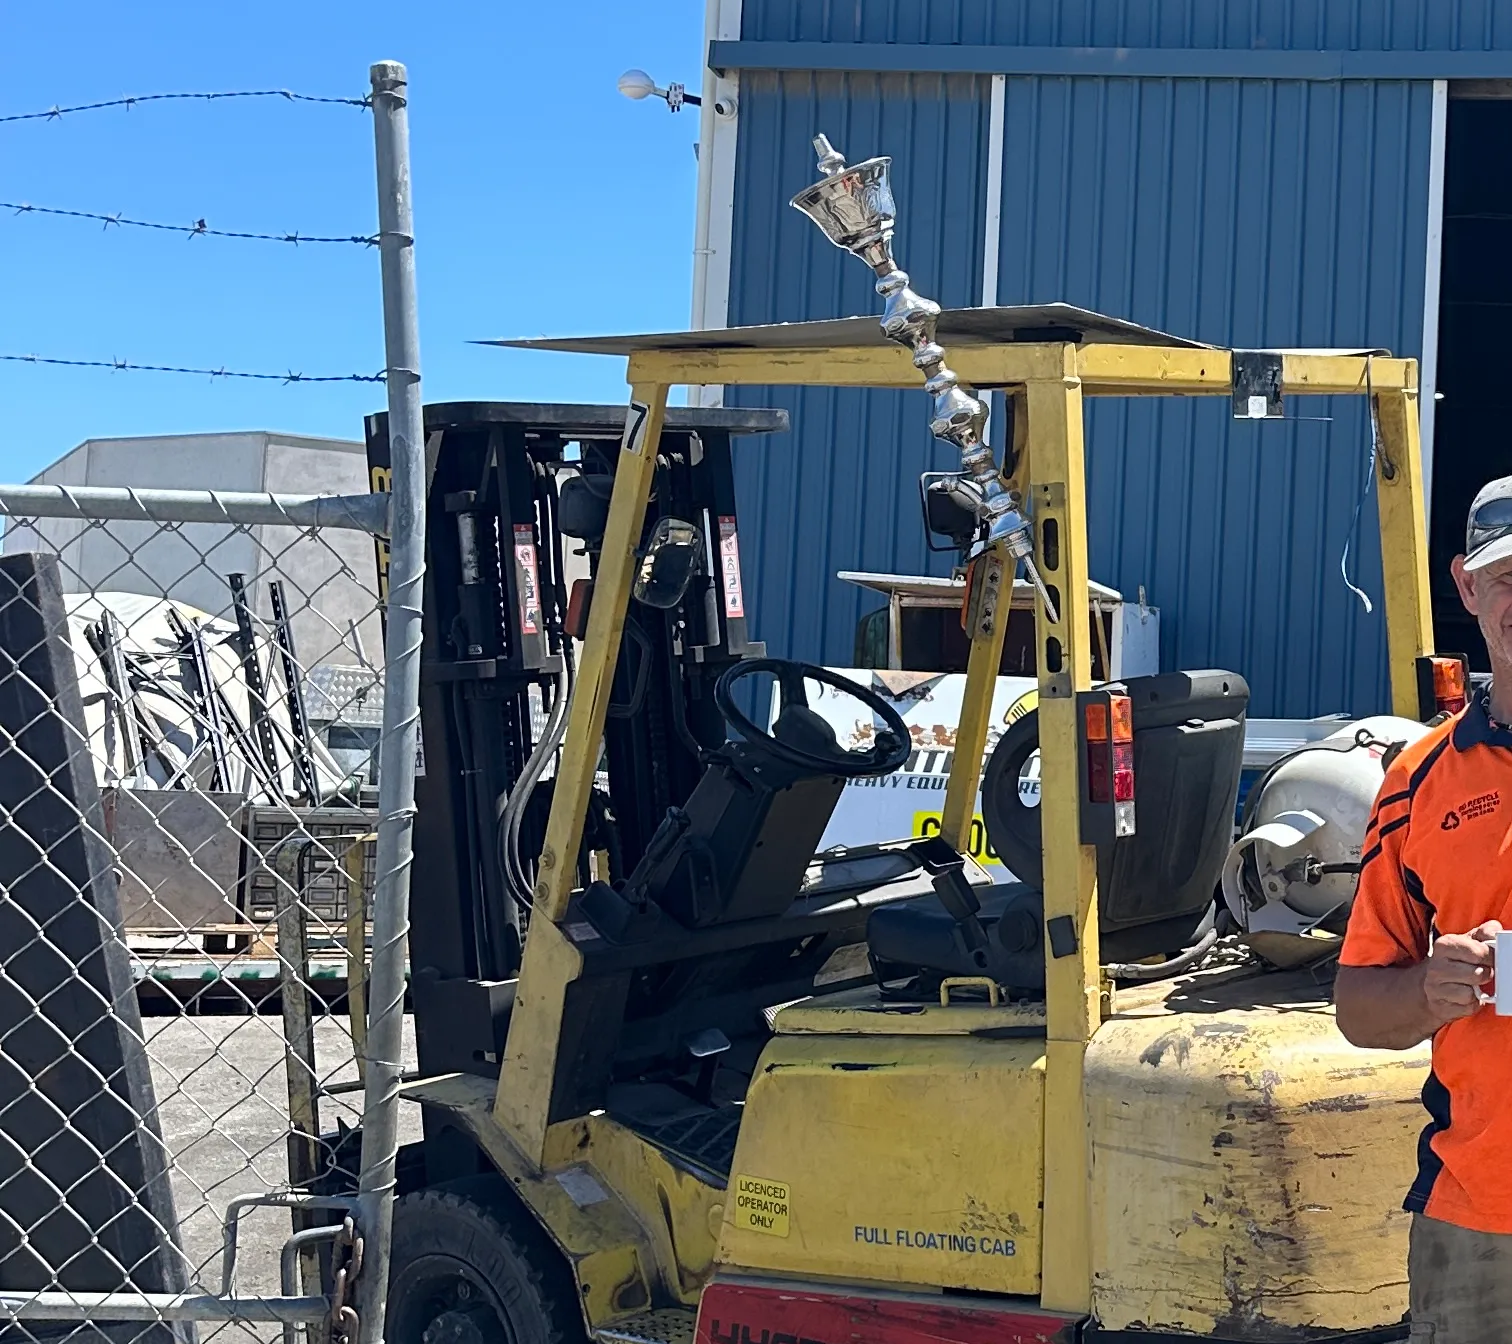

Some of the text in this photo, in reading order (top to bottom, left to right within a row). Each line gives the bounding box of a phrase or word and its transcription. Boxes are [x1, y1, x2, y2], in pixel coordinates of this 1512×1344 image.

[627, 403, 647, 450] 7
[739, 1180, 786, 1199] LICENCED
[737, 1195, 788, 1216] OPERATOR
[750, 1213, 774, 1229] ONLY
[854, 1226, 1016, 1257] FULL FLOATING CAB
